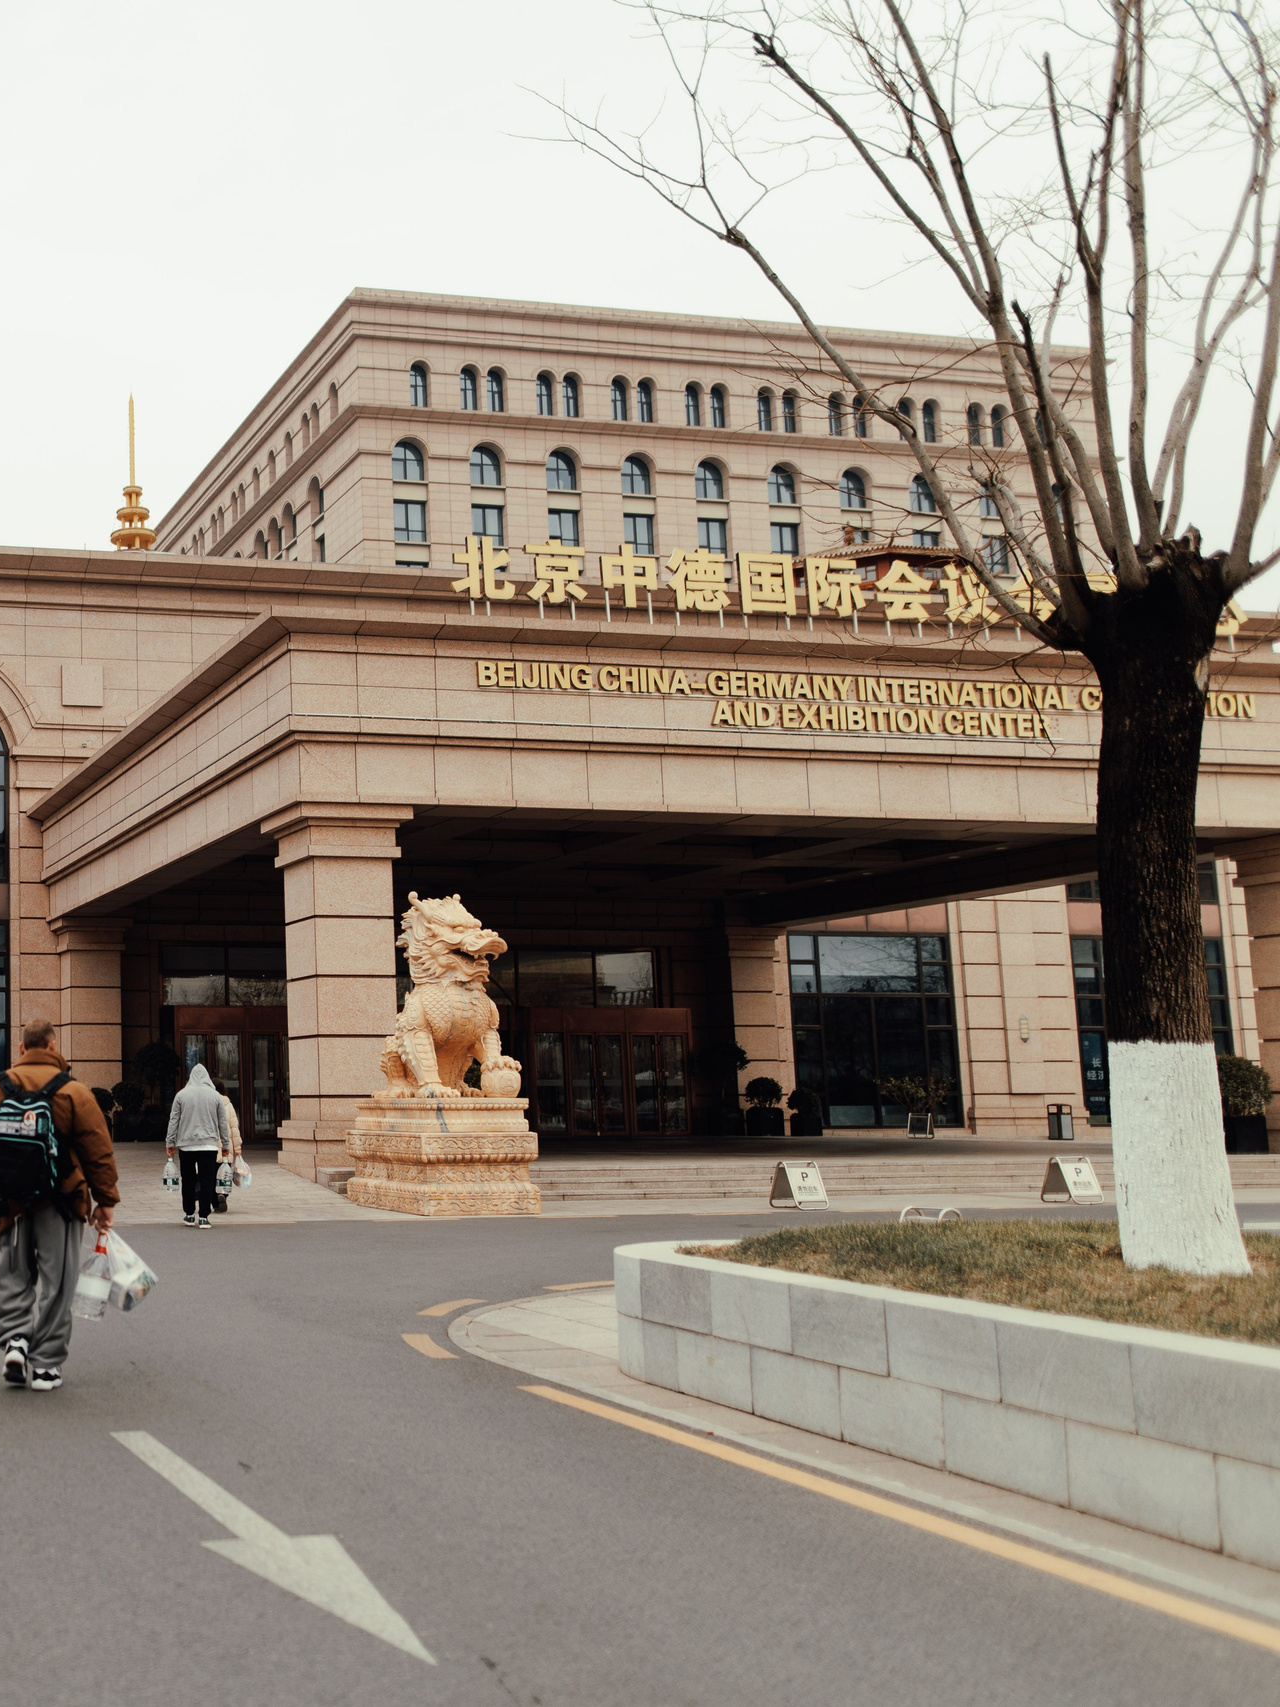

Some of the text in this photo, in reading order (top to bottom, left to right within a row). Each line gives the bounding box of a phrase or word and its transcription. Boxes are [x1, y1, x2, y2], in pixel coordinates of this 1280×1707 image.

[477, 660, 593, 690] BEIJING
[858, 676, 1076, 711] INTERNATIONAL
[713, 700, 1050, 739] AND EXHIBITION CENTER
[801, 1172, 809, 1181] P
[1074, 1168, 1082, 1177] P
